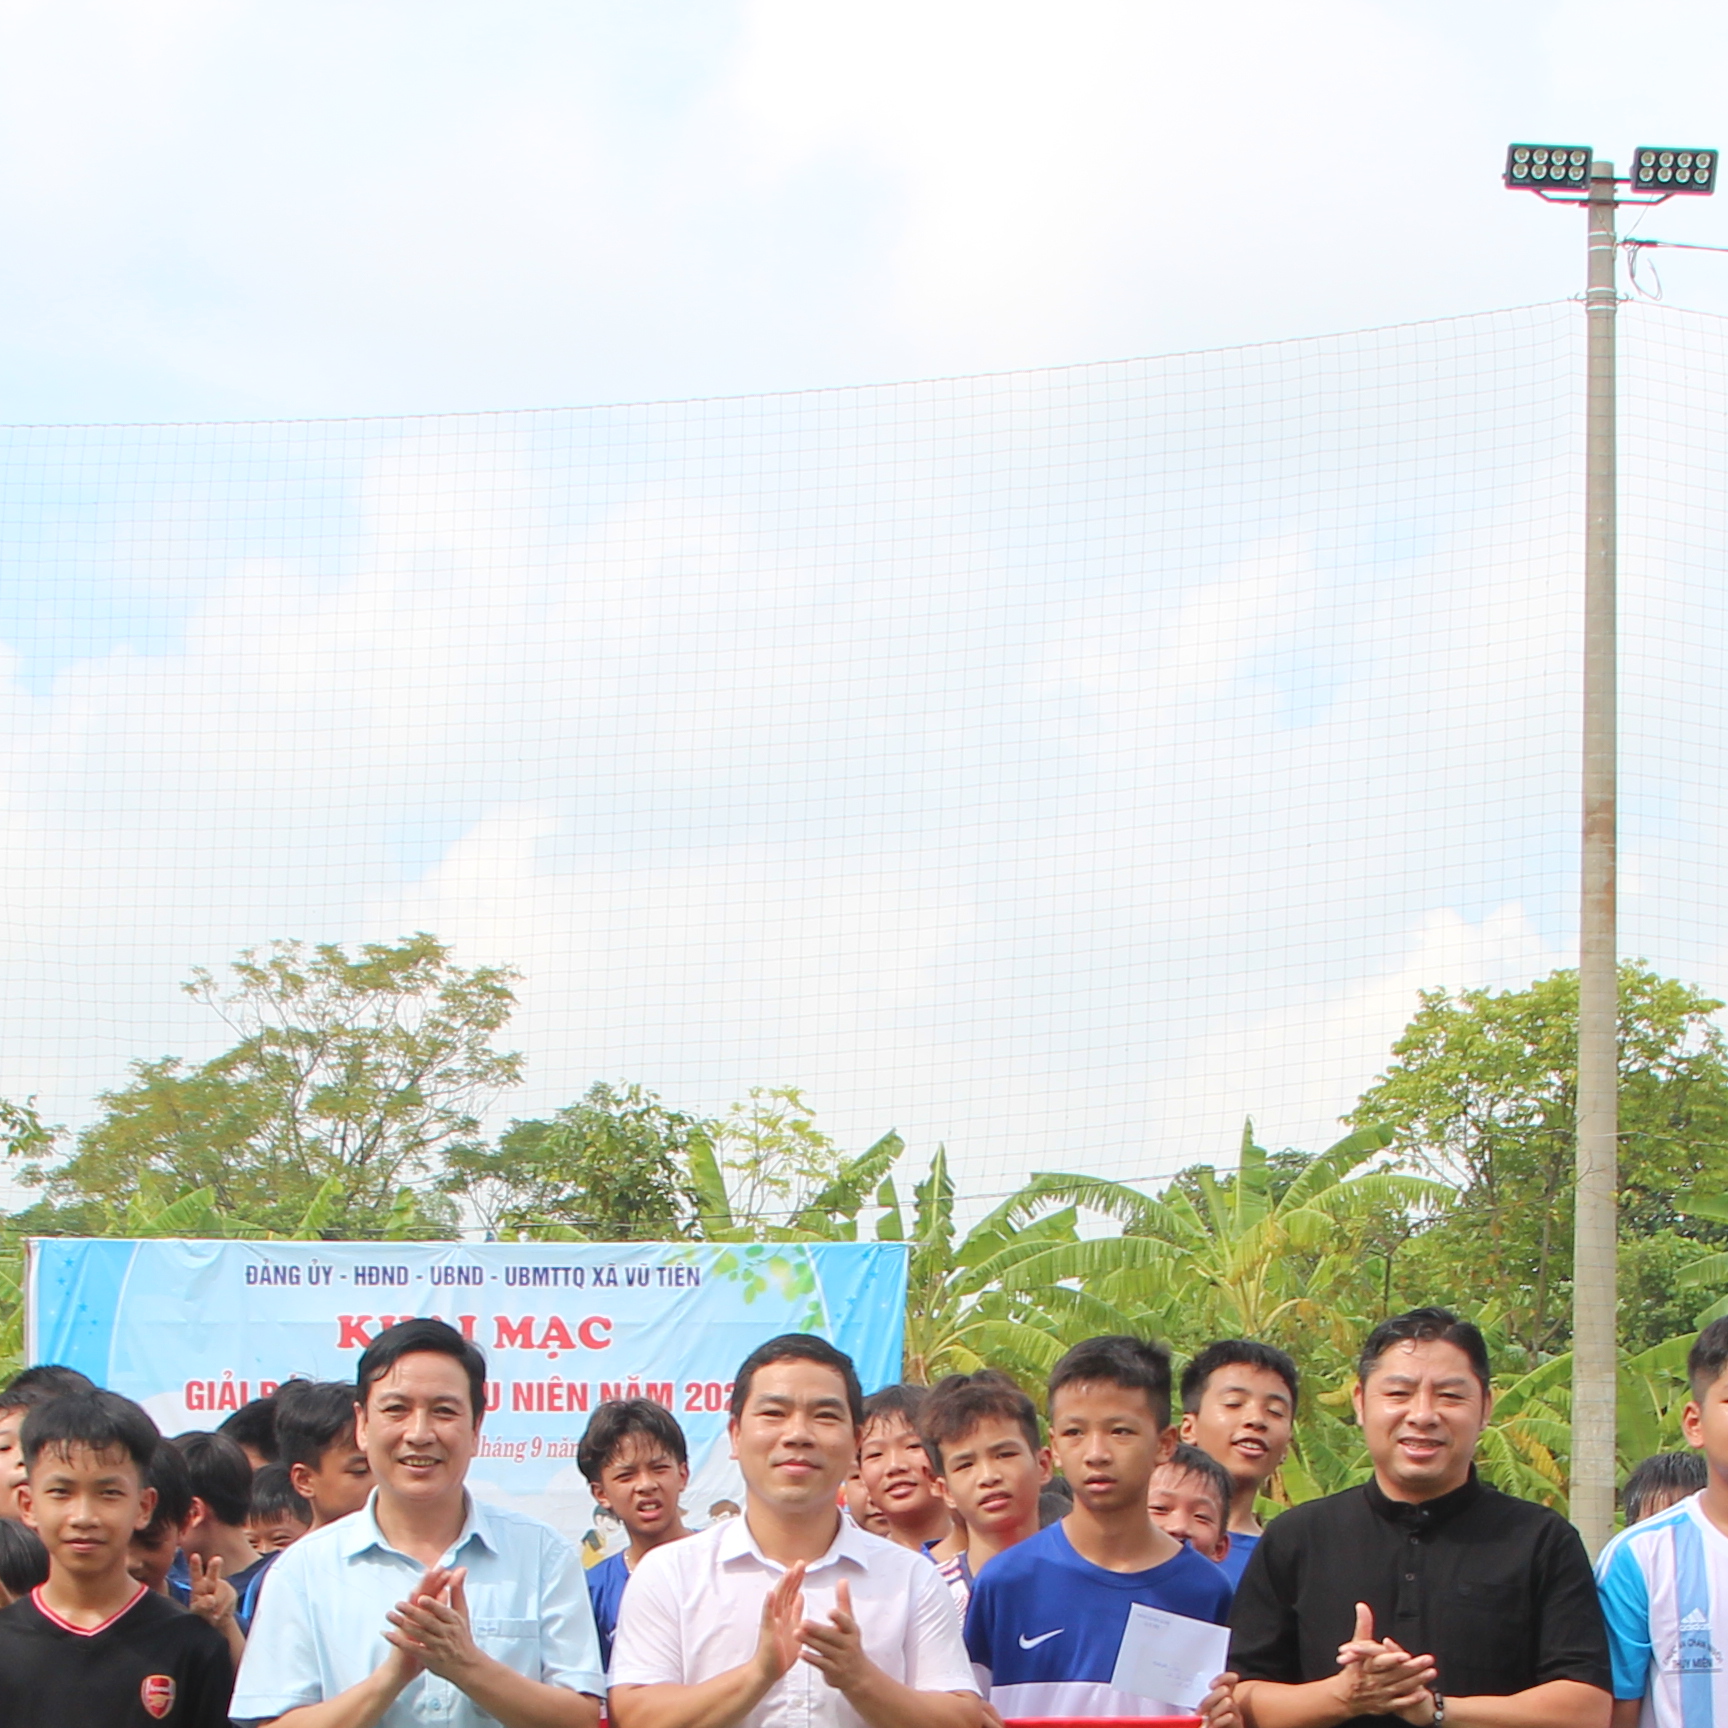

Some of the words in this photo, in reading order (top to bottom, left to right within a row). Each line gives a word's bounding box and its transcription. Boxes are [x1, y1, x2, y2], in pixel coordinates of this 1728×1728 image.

[245, 1258, 301, 1286] ĐẢNG
[308, 1258, 333, 1286] ỦY
[354, 1266, 409, 1286] HĐND
[430, 1266, 484, 1286] UBND
[505, 1266, 585, 1288] UBMTTQ
[591, 1263, 619, 1287] XÃ
[625, 1263, 650, 1287] VŨ
[656, 1263, 701, 1287] TIÊN
[493, 1315, 613, 1359] MẠC
[185, 1370, 249, 1410] GIẢI
[512, 1375, 588, 1411] NIÊN
[479, 1436, 526, 1462] háng
[531, 1436, 542, 1457] 9
